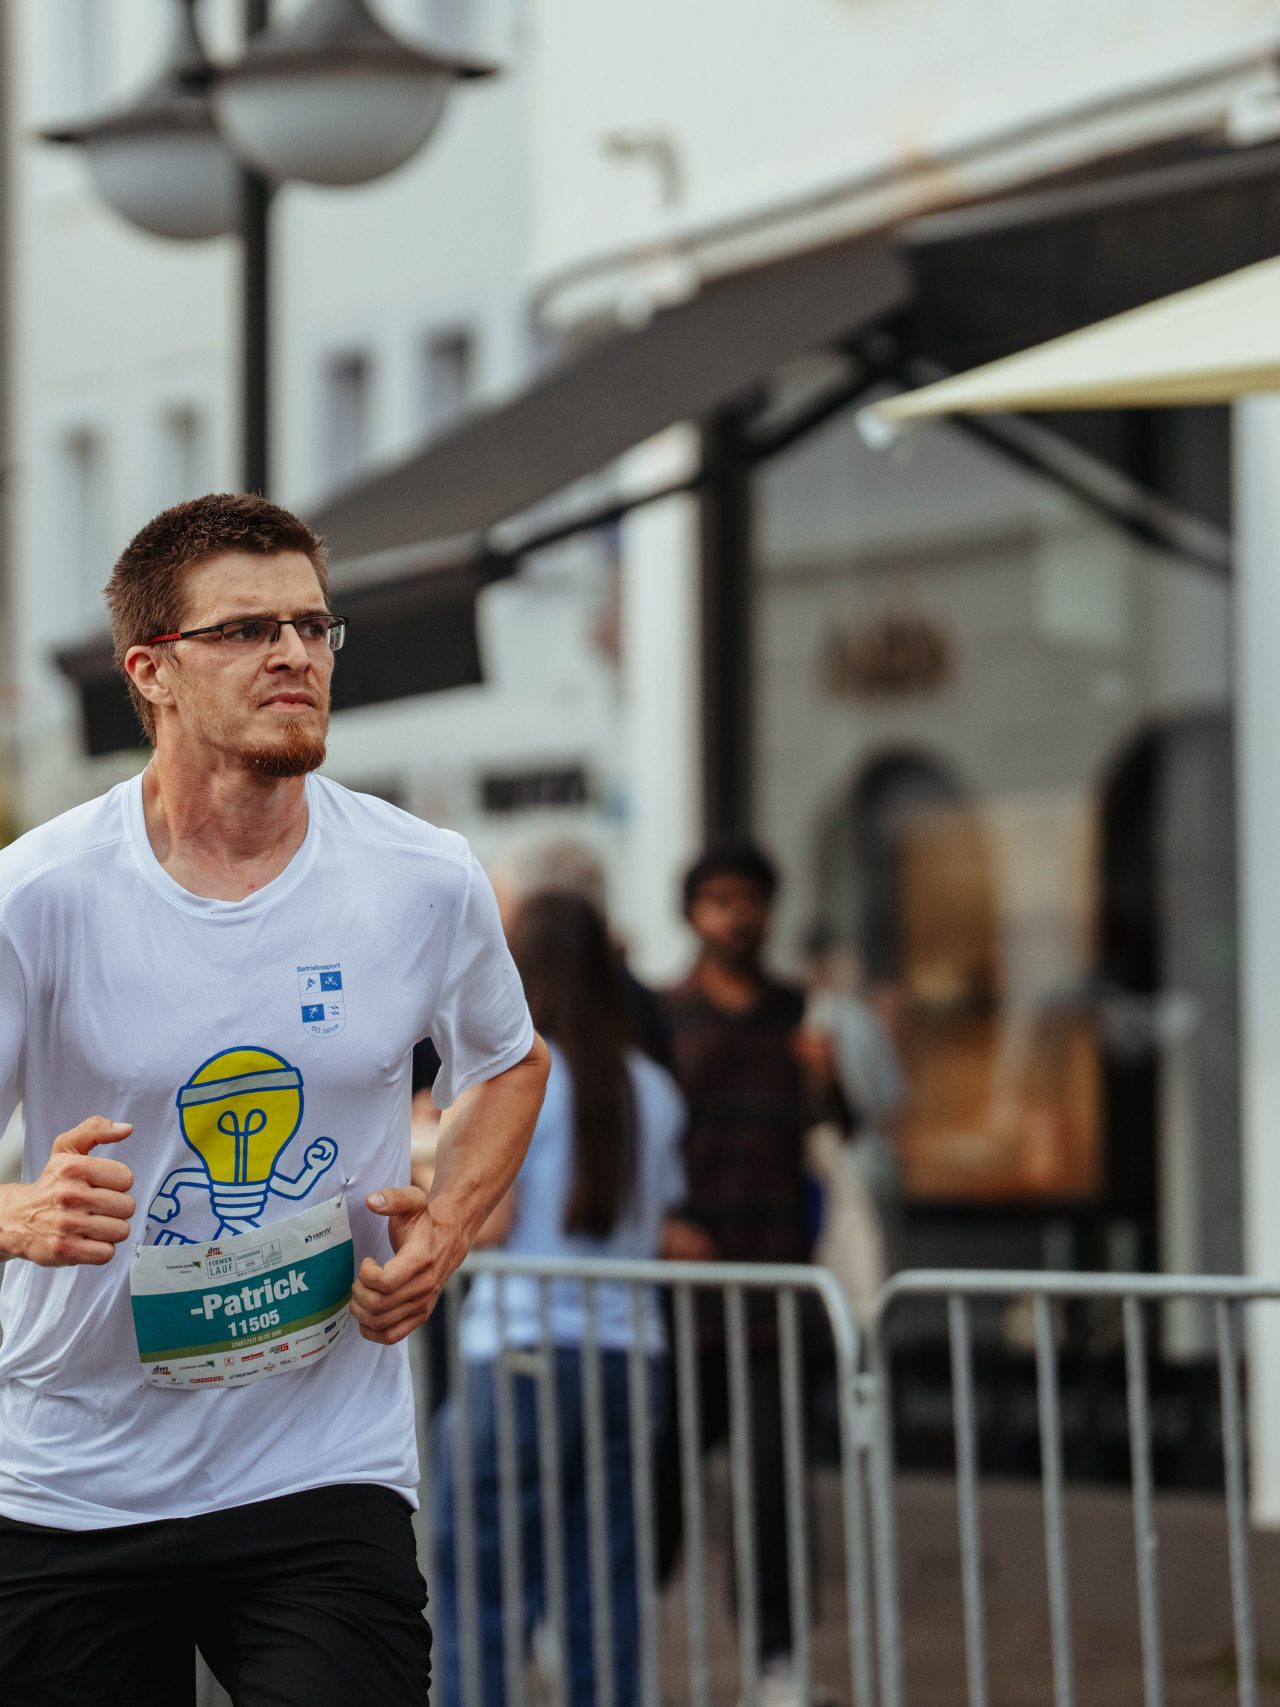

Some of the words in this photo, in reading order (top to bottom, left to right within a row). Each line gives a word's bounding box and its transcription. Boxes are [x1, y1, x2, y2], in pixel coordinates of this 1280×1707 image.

[296, 963, 341, 973] Betriebssport
[207, 1246, 220, 1254] dm
[208, 1256, 233, 1266] FIRMEN
[209, 1265, 233, 1276] LAUF
[190, 1269, 309, 1320] -Patrick
[228, 1309, 280, 1337] 11505
[152, 1365, 169, 1373] dm
